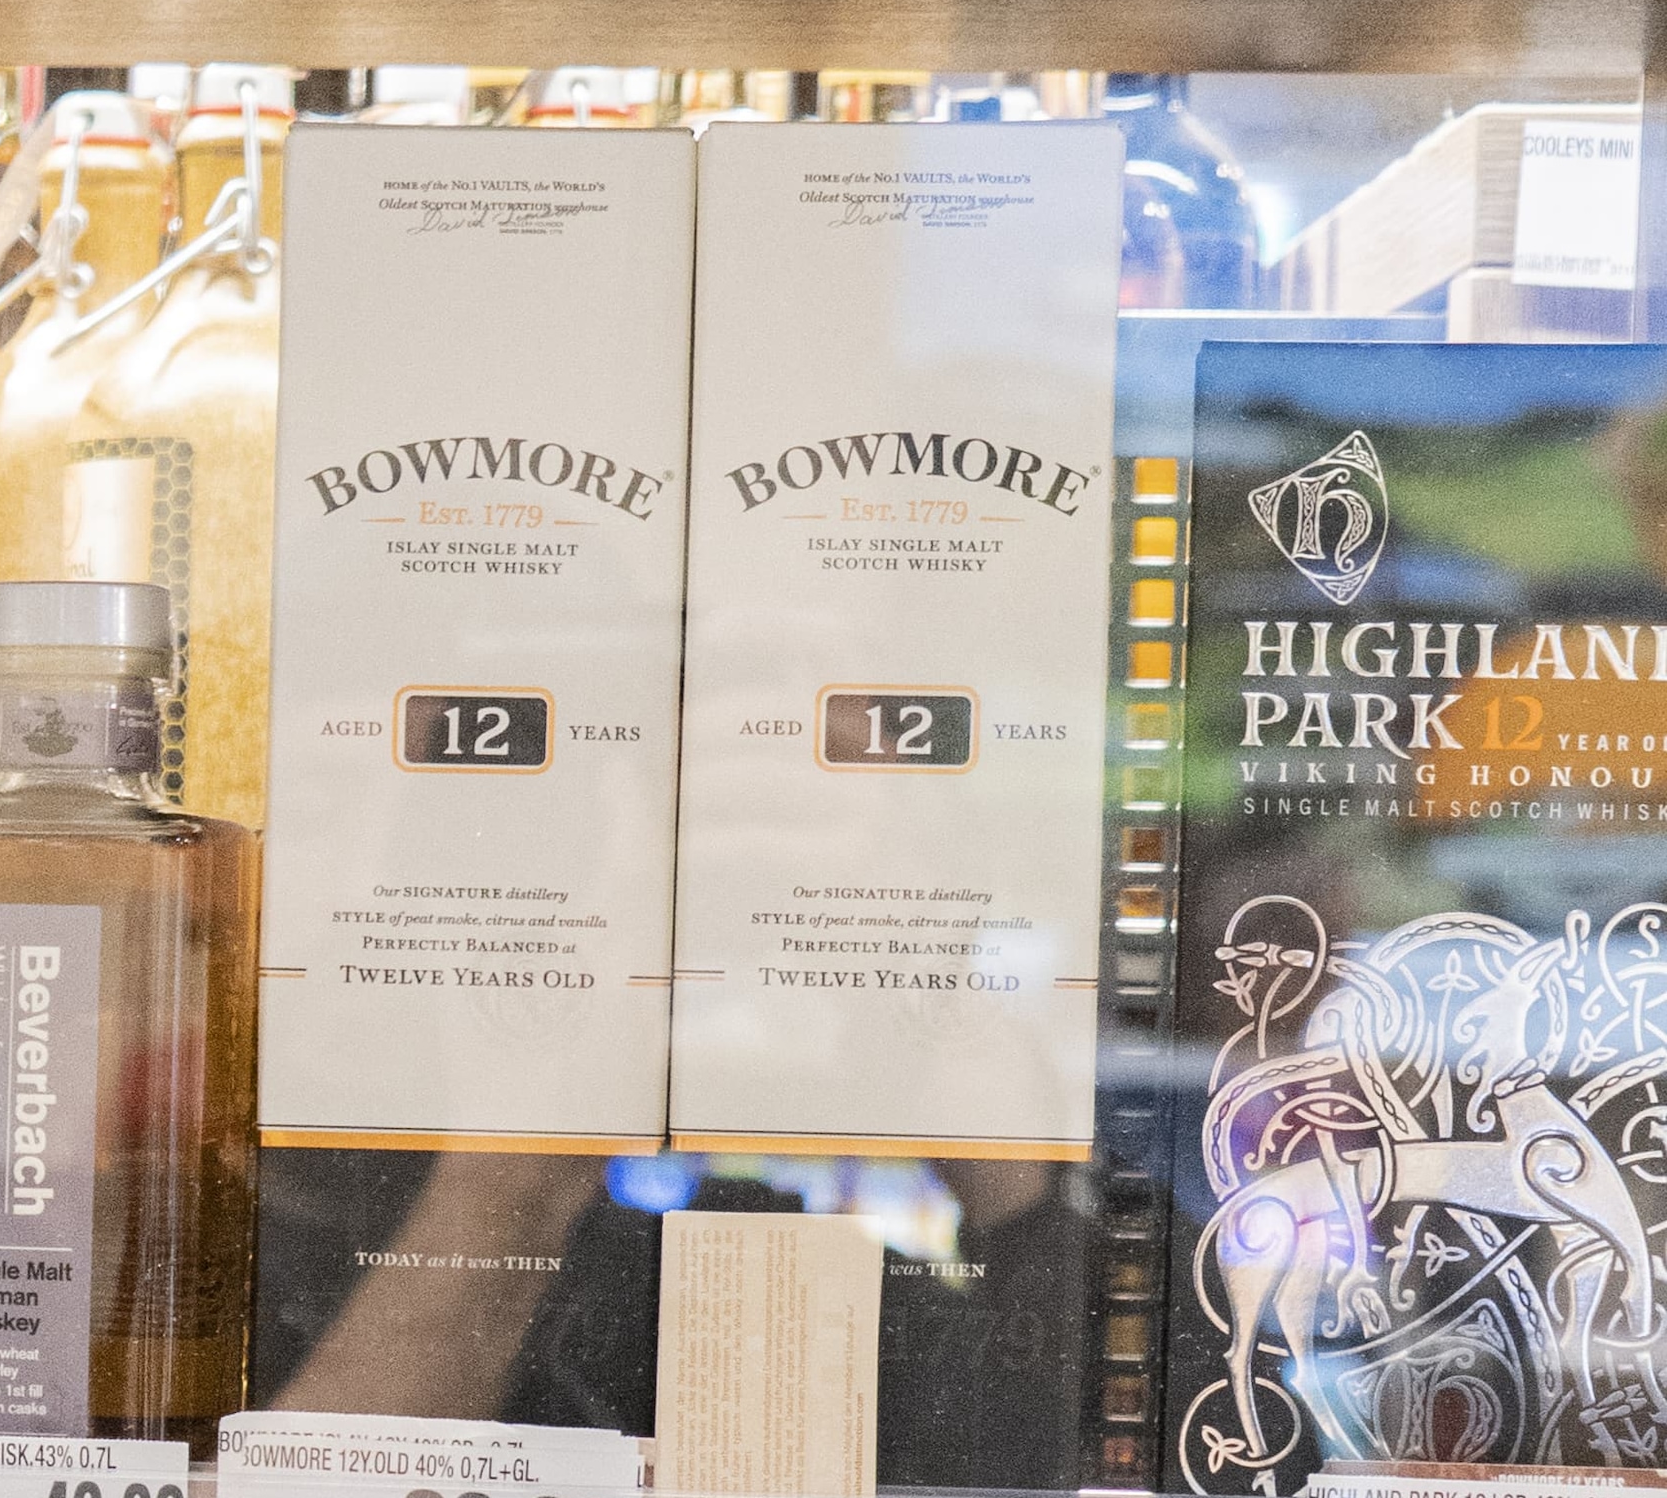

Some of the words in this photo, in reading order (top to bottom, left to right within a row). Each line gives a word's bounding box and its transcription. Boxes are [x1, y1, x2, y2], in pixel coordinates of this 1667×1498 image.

[305, 436, 664, 522] BOWMORE
[724, 432, 1091, 516] BOWMORE
[484, 503, 544, 528] 1779
[909, 500, 969, 524] 1779
[387, 541, 440, 555] ISLAY
[448, 542, 516, 556] SINGLE
[525, 543, 579, 557] MALT
[401, 560, 476, 574] SCOTCH
[486, 562, 562, 576] WHISKY
[1242, 621, 1667, 681] HIGHLAN
[321, 721, 382, 736] AGED
[443, 707, 510, 756] 12
[570, 726, 641, 741] YEARS
[864, 705, 934, 756] 12
[1240, 691, 1464, 759] PARK
[1481, 696, 1544, 751] 12
[1558, 734, 1628, 751] YEAR
[1240, 762, 1436, 785] VIKING
[1244, 798, 1349, 815] SINGLE
[1365, 800, 1436, 817] MALT
[1450, 800, 1563, 819] SCOTCH
[12, 945, 61, 1216] Beverbach
[27, 1260, 73, 1282] Malt
[356, 1251, 423, 1267] TODAY
[427, 1257, 446, 1268] as
[450, 1255, 464, 1269] it
[468, 1258, 500, 1270] was
[504, 1255, 562, 1271] THEN
[79, 1446, 117, 1469] 0.7L
[338, 1450, 408, 1475] 12Y.OLD
[415, 1453, 454, 1478] 40%
